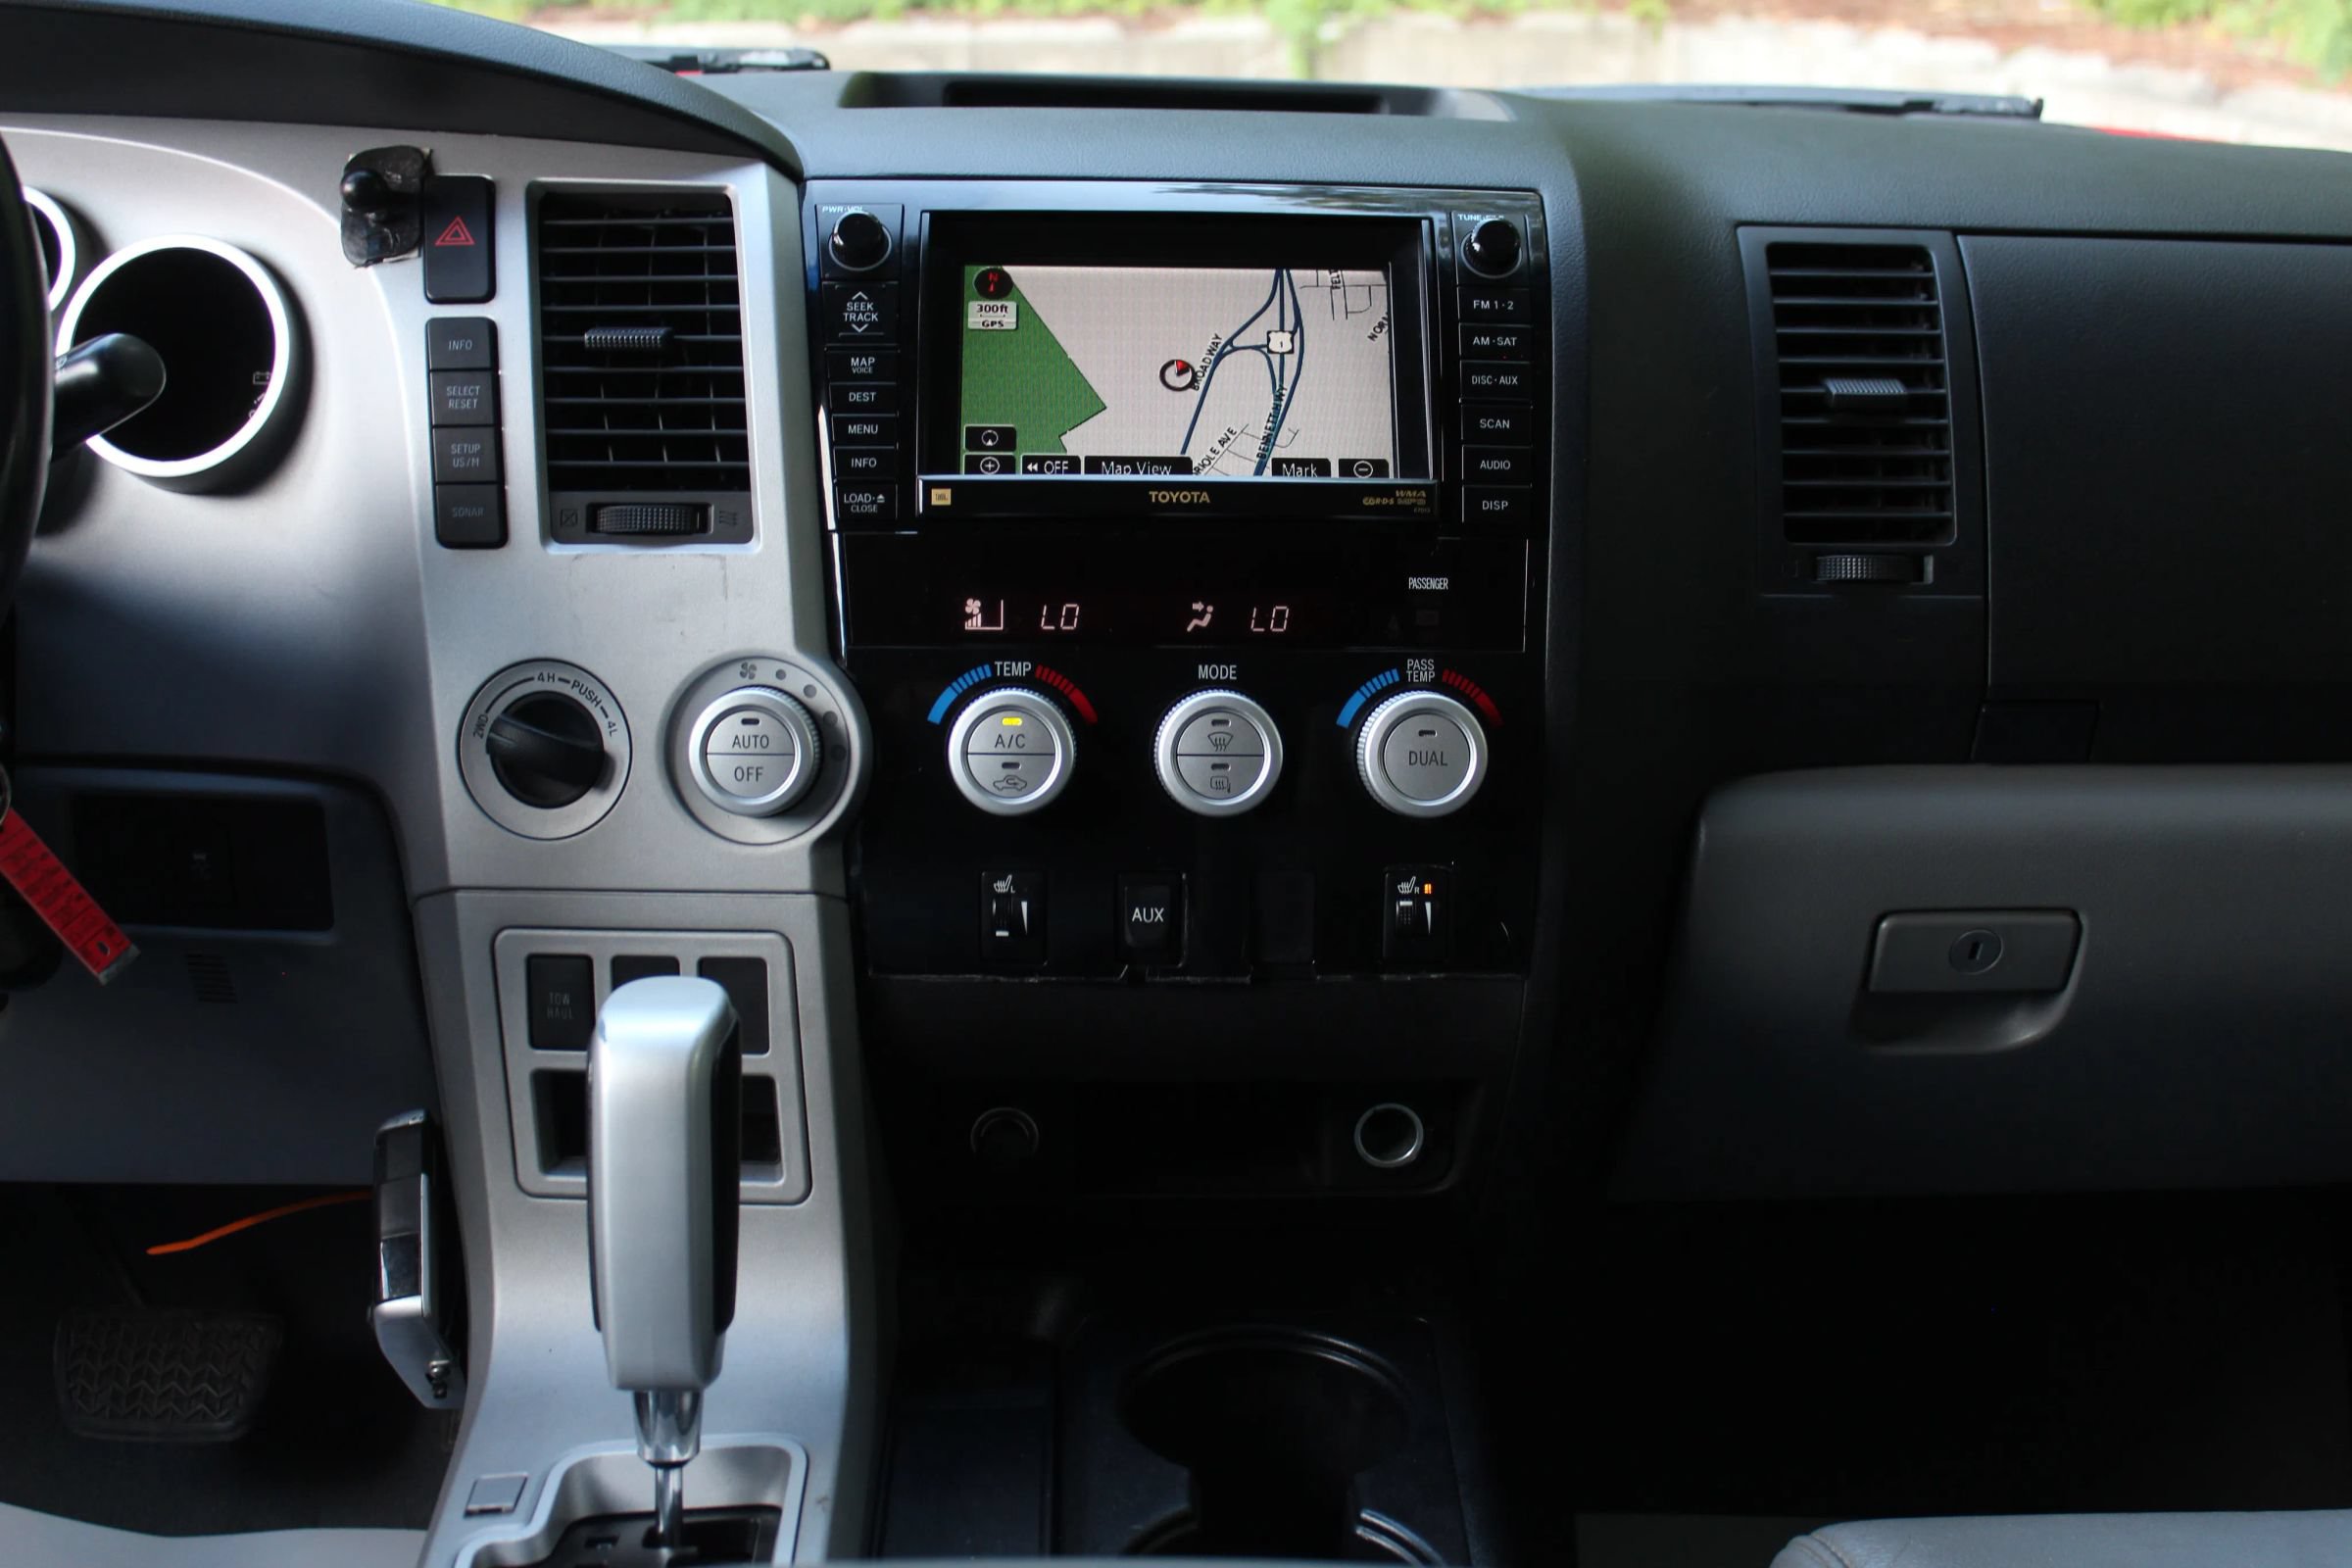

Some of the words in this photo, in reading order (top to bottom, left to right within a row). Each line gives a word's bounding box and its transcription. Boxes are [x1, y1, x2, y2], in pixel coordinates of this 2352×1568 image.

[847, 302, 874, 312] SEEK
[1473, 300, 1491, 310] FM
[843, 313, 879, 321] TRACK
[448, 339, 472, 351] INFO
[851, 357, 875, 367] MAP
[1192, 333, 1223, 391] BROADWAY
[446, 385, 480, 397] SELECT
[849, 392, 877, 402] DEST
[448, 398, 478, 409] RESET
[848, 424, 878, 434] MENU
[1480, 418, 1510, 429] SCAN
[1217, 427, 1237, 448] AVE
[451, 443, 481, 455] SETUP
[453, 457, 479, 468] US/M
[851, 458, 877, 468] INFO
[1480, 460, 1511, 470] AUDIO
[1043, 461, 1069, 474] OFF
[1102, 462, 1131, 475] Map
[1137, 462, 1172, 475] View
[1282, 464, 1318, 477] Mark
[1149, 491, 1211, 504] TOYOTA
[851, 504, 878, 513] CLOSE
[1482, 500, 1509, 511] DISP
[452, 507, 485, 517] SONAR
[1408, 576, 1449, 590] PASSENGER
[994, 661, 1032, 678] TEMP
[1406, 659, 1435, 671] PASS
[1198, 664, 1238, 681] MODE
[1406, 671, 1436, 683] TEMP
[472, 713, 489, 740] 2WD
[537, 672, 556, 683] 4H
[570, 679, 603, 708] PUSH
[607, 719, 618, 737] 4L
[731, 734, 769, 750] AUTO
[995, 733, 1026, 749] A/C
[1407, 750, 1448, 767] DUAL
[734, 766, 764, 783] OFF
[1132, 907, 1164, 923] AUX
[549, 992, 570, 1004] TOW
[547, 1006, 573, 1019] HAUL
